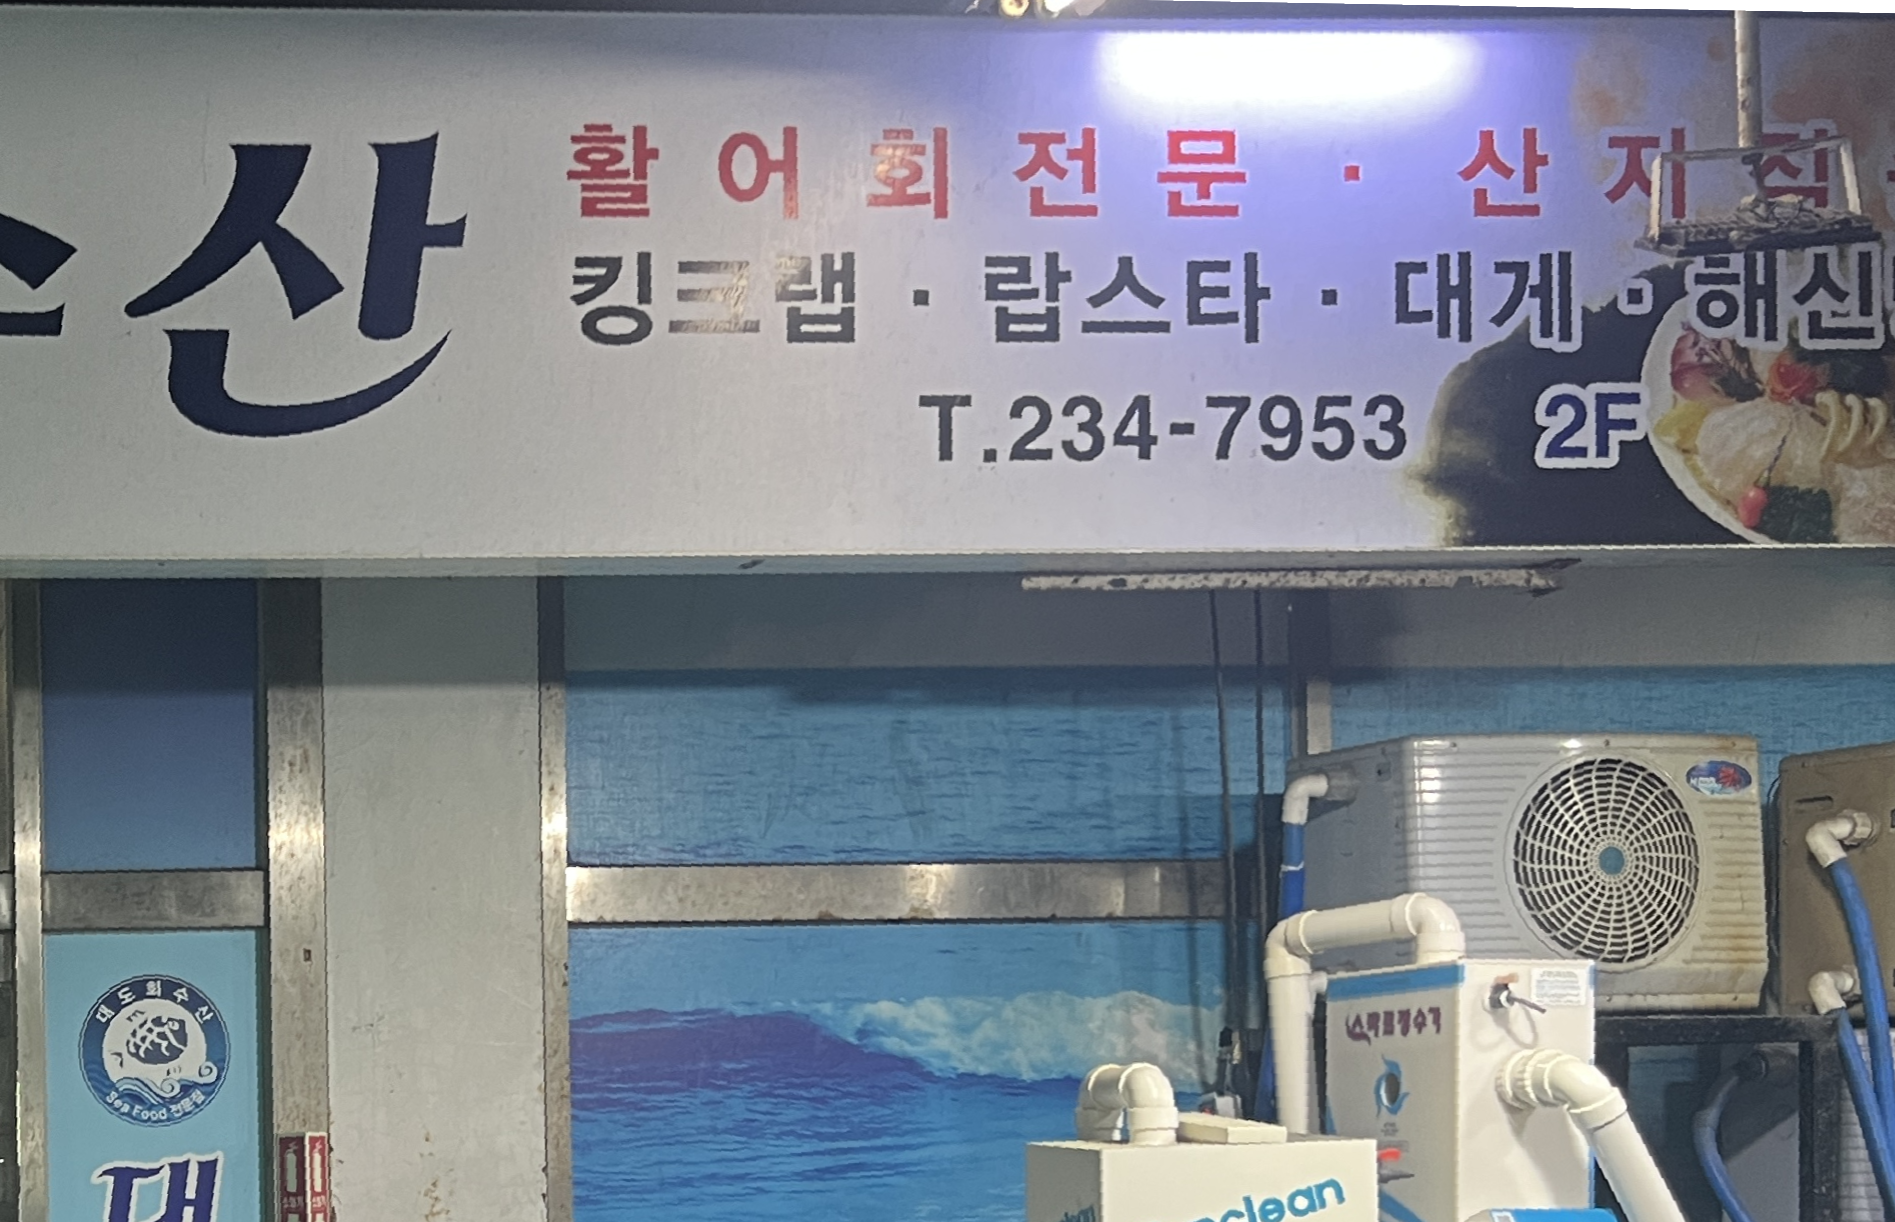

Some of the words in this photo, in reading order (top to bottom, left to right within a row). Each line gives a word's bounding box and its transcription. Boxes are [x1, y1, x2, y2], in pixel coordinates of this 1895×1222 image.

[571, 252, 856, 345] 킹크랩
[983, 252, 1271, 343] 랍스타
[1395, 250, 1572, 343] 대게
[919, 394, 1406, 462] T.234-7953
[1545, 392, 1641, 458] 2F
[106, 1091, 130, 1113] Sea
[132, 1107, 168, 1120] Food
